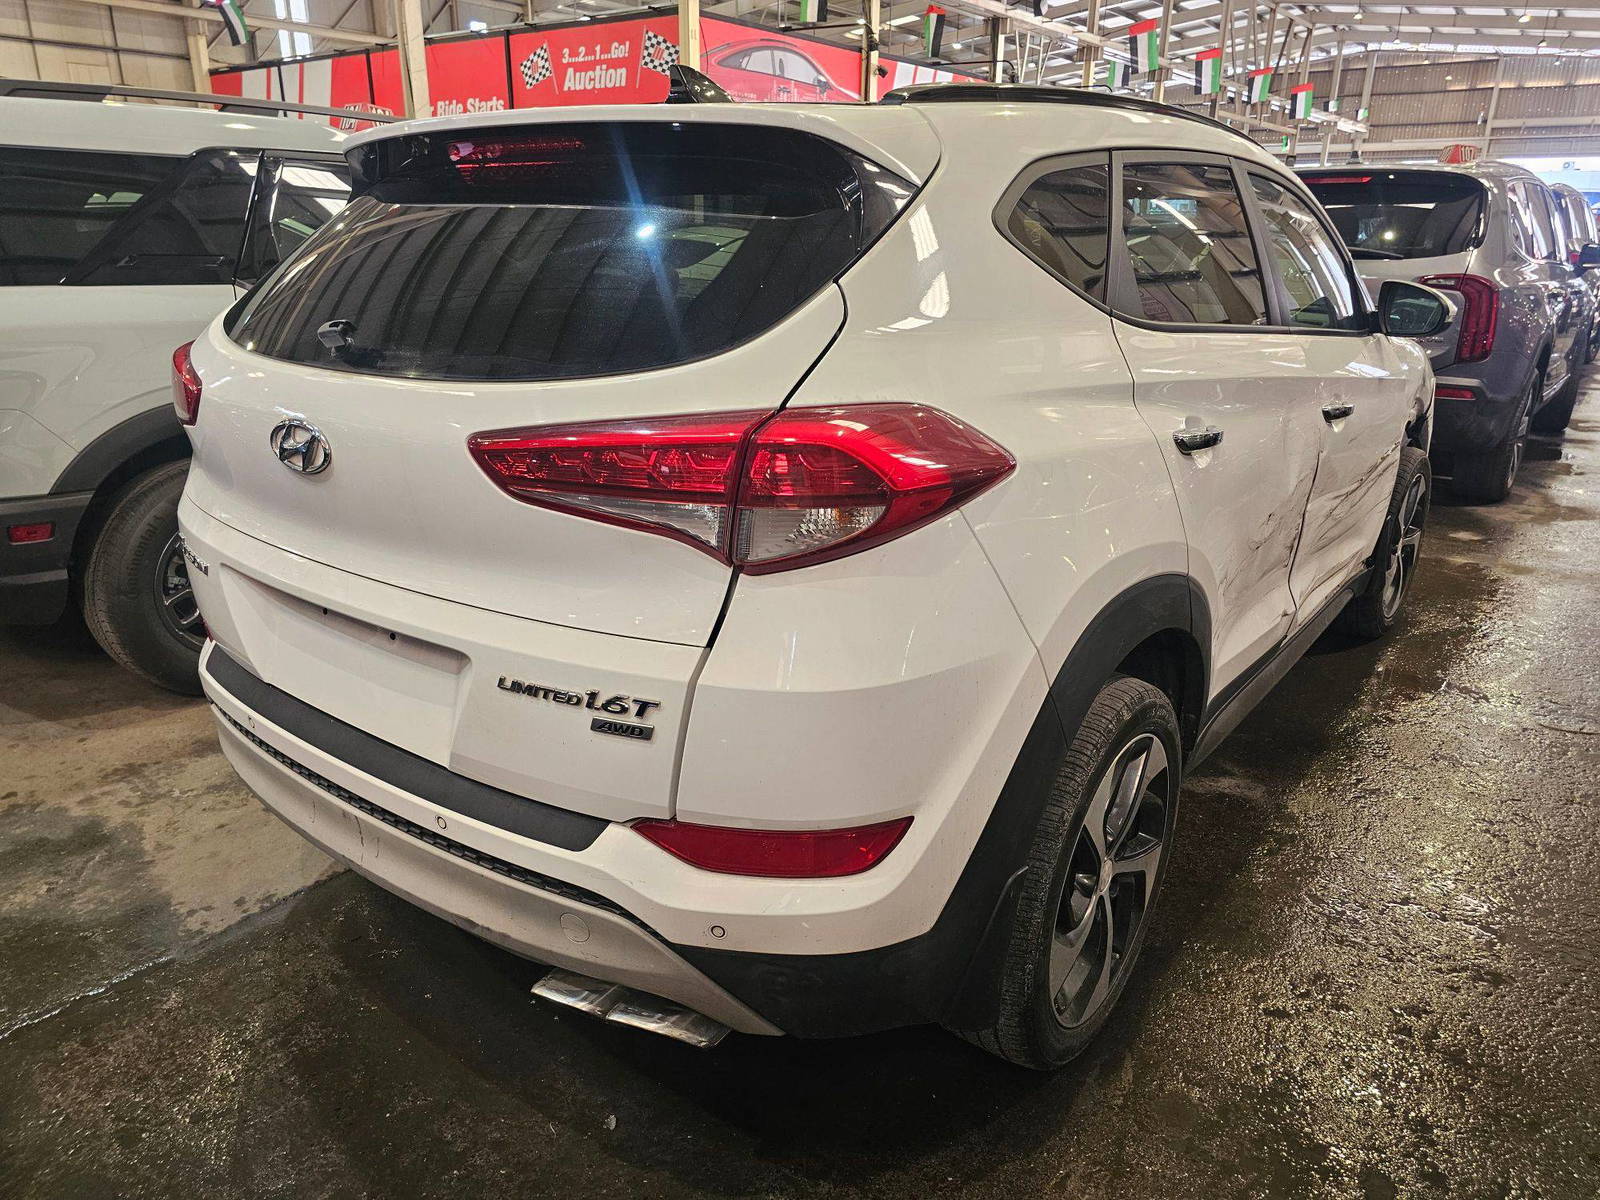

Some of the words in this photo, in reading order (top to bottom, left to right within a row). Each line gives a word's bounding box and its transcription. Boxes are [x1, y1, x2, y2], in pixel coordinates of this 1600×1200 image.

[563, 64, 627, 91] Auction
[437, 99, 463, 117] Ride
[467, 96, 504, 113] Starts
[497, 676, 583, 706] LIMITED
[584, 689, 661, 720] 1.6T
[597, 720, 646, 738] AWD
